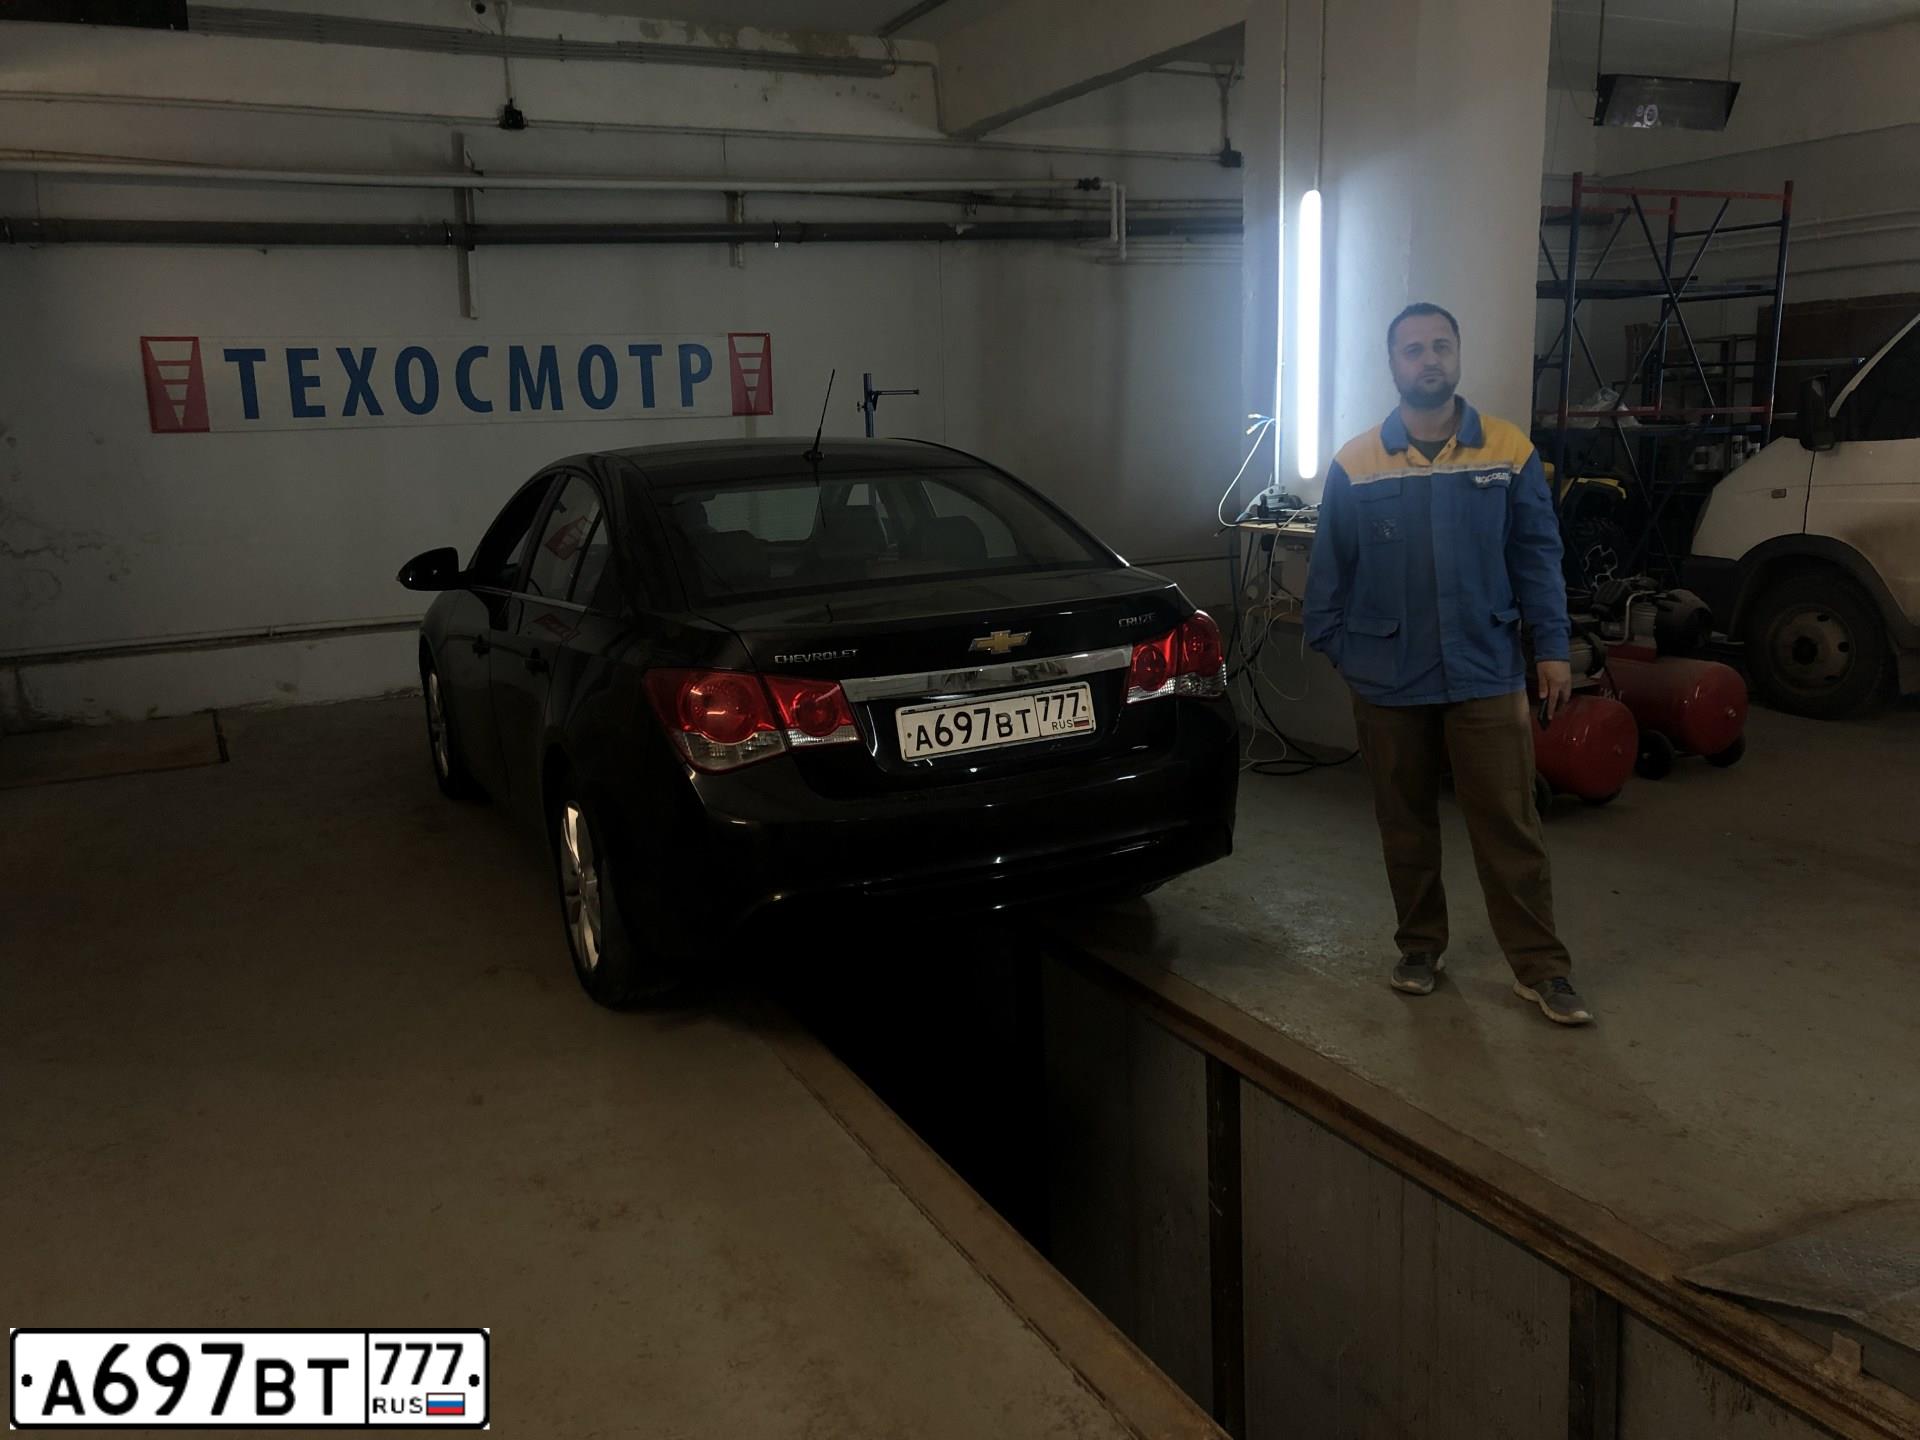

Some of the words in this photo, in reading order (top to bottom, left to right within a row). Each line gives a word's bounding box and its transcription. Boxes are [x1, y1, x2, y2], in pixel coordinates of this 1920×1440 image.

[224, 344, 712, 420] ТЕХОСМОТР
[774, 649, 860, 664] CHEVROLET
[916, 708, 1031, 751] А697ВТ
[1037, 692, 1080, 722] 777
[1052, 719, 1074, 730] RUS
